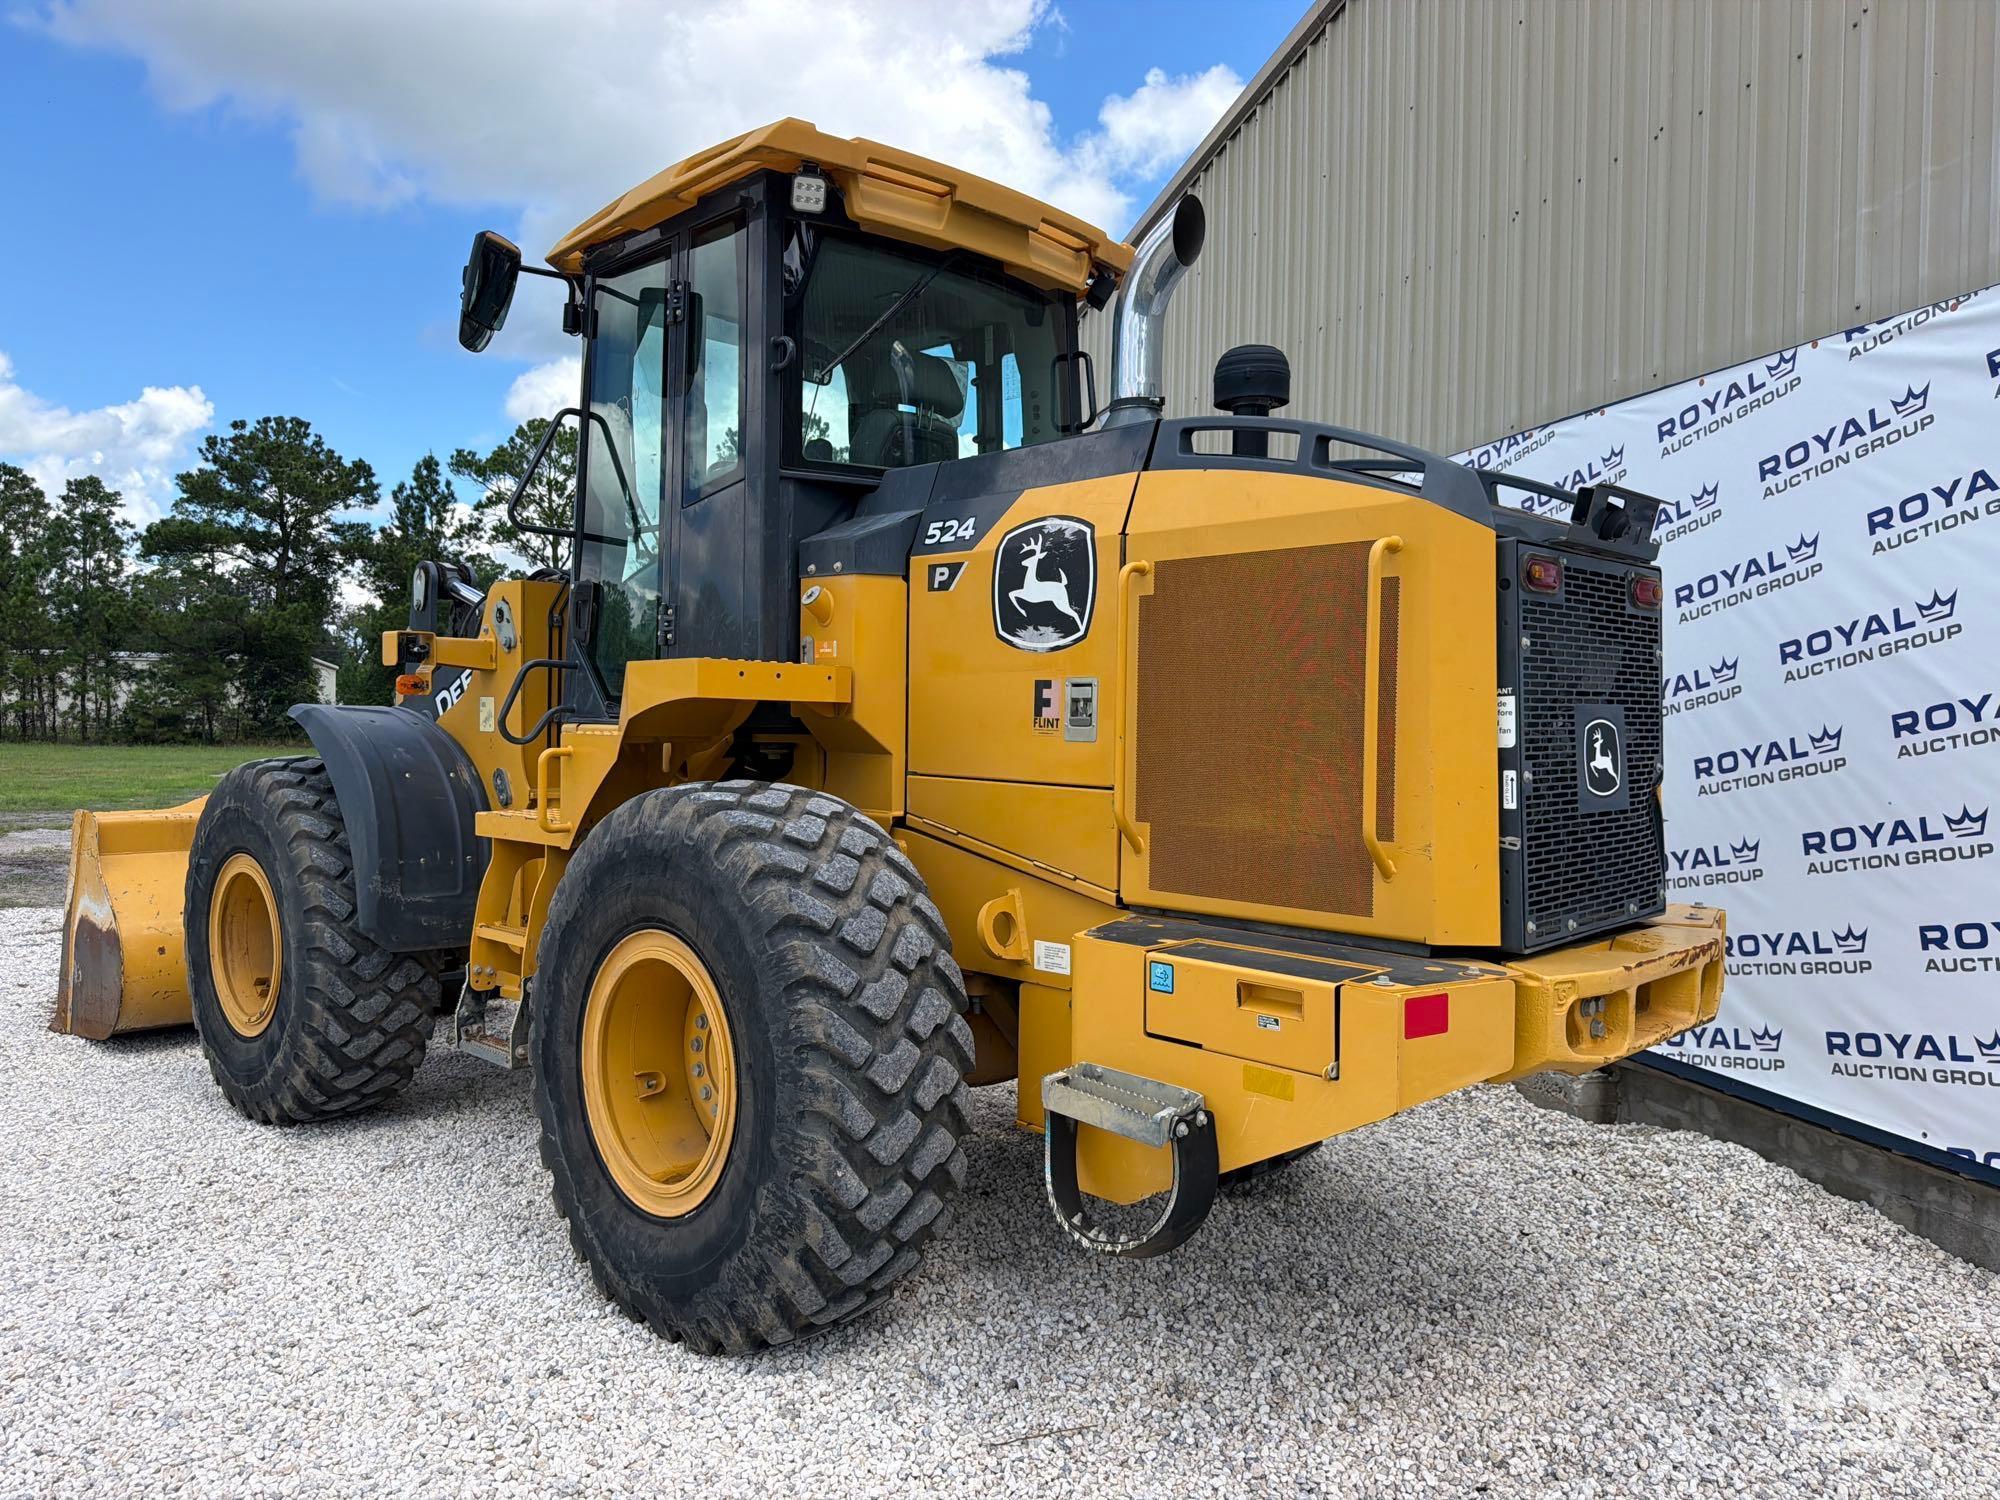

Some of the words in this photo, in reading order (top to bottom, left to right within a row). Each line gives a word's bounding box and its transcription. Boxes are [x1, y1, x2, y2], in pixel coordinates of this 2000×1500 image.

[1657, 372, 1767, 443] ROYAL
[1661, 411, 1733, 459] AUCTION
[1736, 376, 1801, 419] GROUP
[1514, 430, 1555, 462] GROUP
[1758, 407, 1892, 483] ROYAL
[1762, 450, 1850, 500] AUCTION
[1854, 413, 1935, 459] GROUP
[1867, 468, 2000, 537] ROYA
[924, 516, 976, 545] 524
[1665, 508, 1722, 543] GROUP
[1872, 505, 1980, 556] AUCTION
[933, 566, 950, 589] P
[1674, 550, 1787, 609] ROYAL
[1678, 587, 1753, 625] AUCTION
[1756, 562, 1823, 597] GROUP
[1778, 606, 1916, 666] ROYAL
[1783, 646, 1874, 684] AUCTION
[1878, 622, 1963, 658] GROUP
[1684, 684, 1743, 712] GROUP
[1033, 717, 1060, 729] FLINT
[1693, 736, 1809, 780] ROYAL
[1697, 771, 1775, 797] AUCTION
[1778, 756, 1847, 782] GROUP
[1802, 816, 1944, 856] ROYAL
[1703, 868, 1764, 886] GROUP
[1806, 852, 1900, 876] AUCTION
[1905, 842, 1994, 866] GROUP
[1801, 960, 1872, 975] GROUP
[1720, 1055, 1785, 1071] GROUP
[1825, 1031, 1975, 1063] ROYAL
[1831, 1062, 1927, 1082] AUCTION
[1932, 1068, 2000, 1088] GROU
